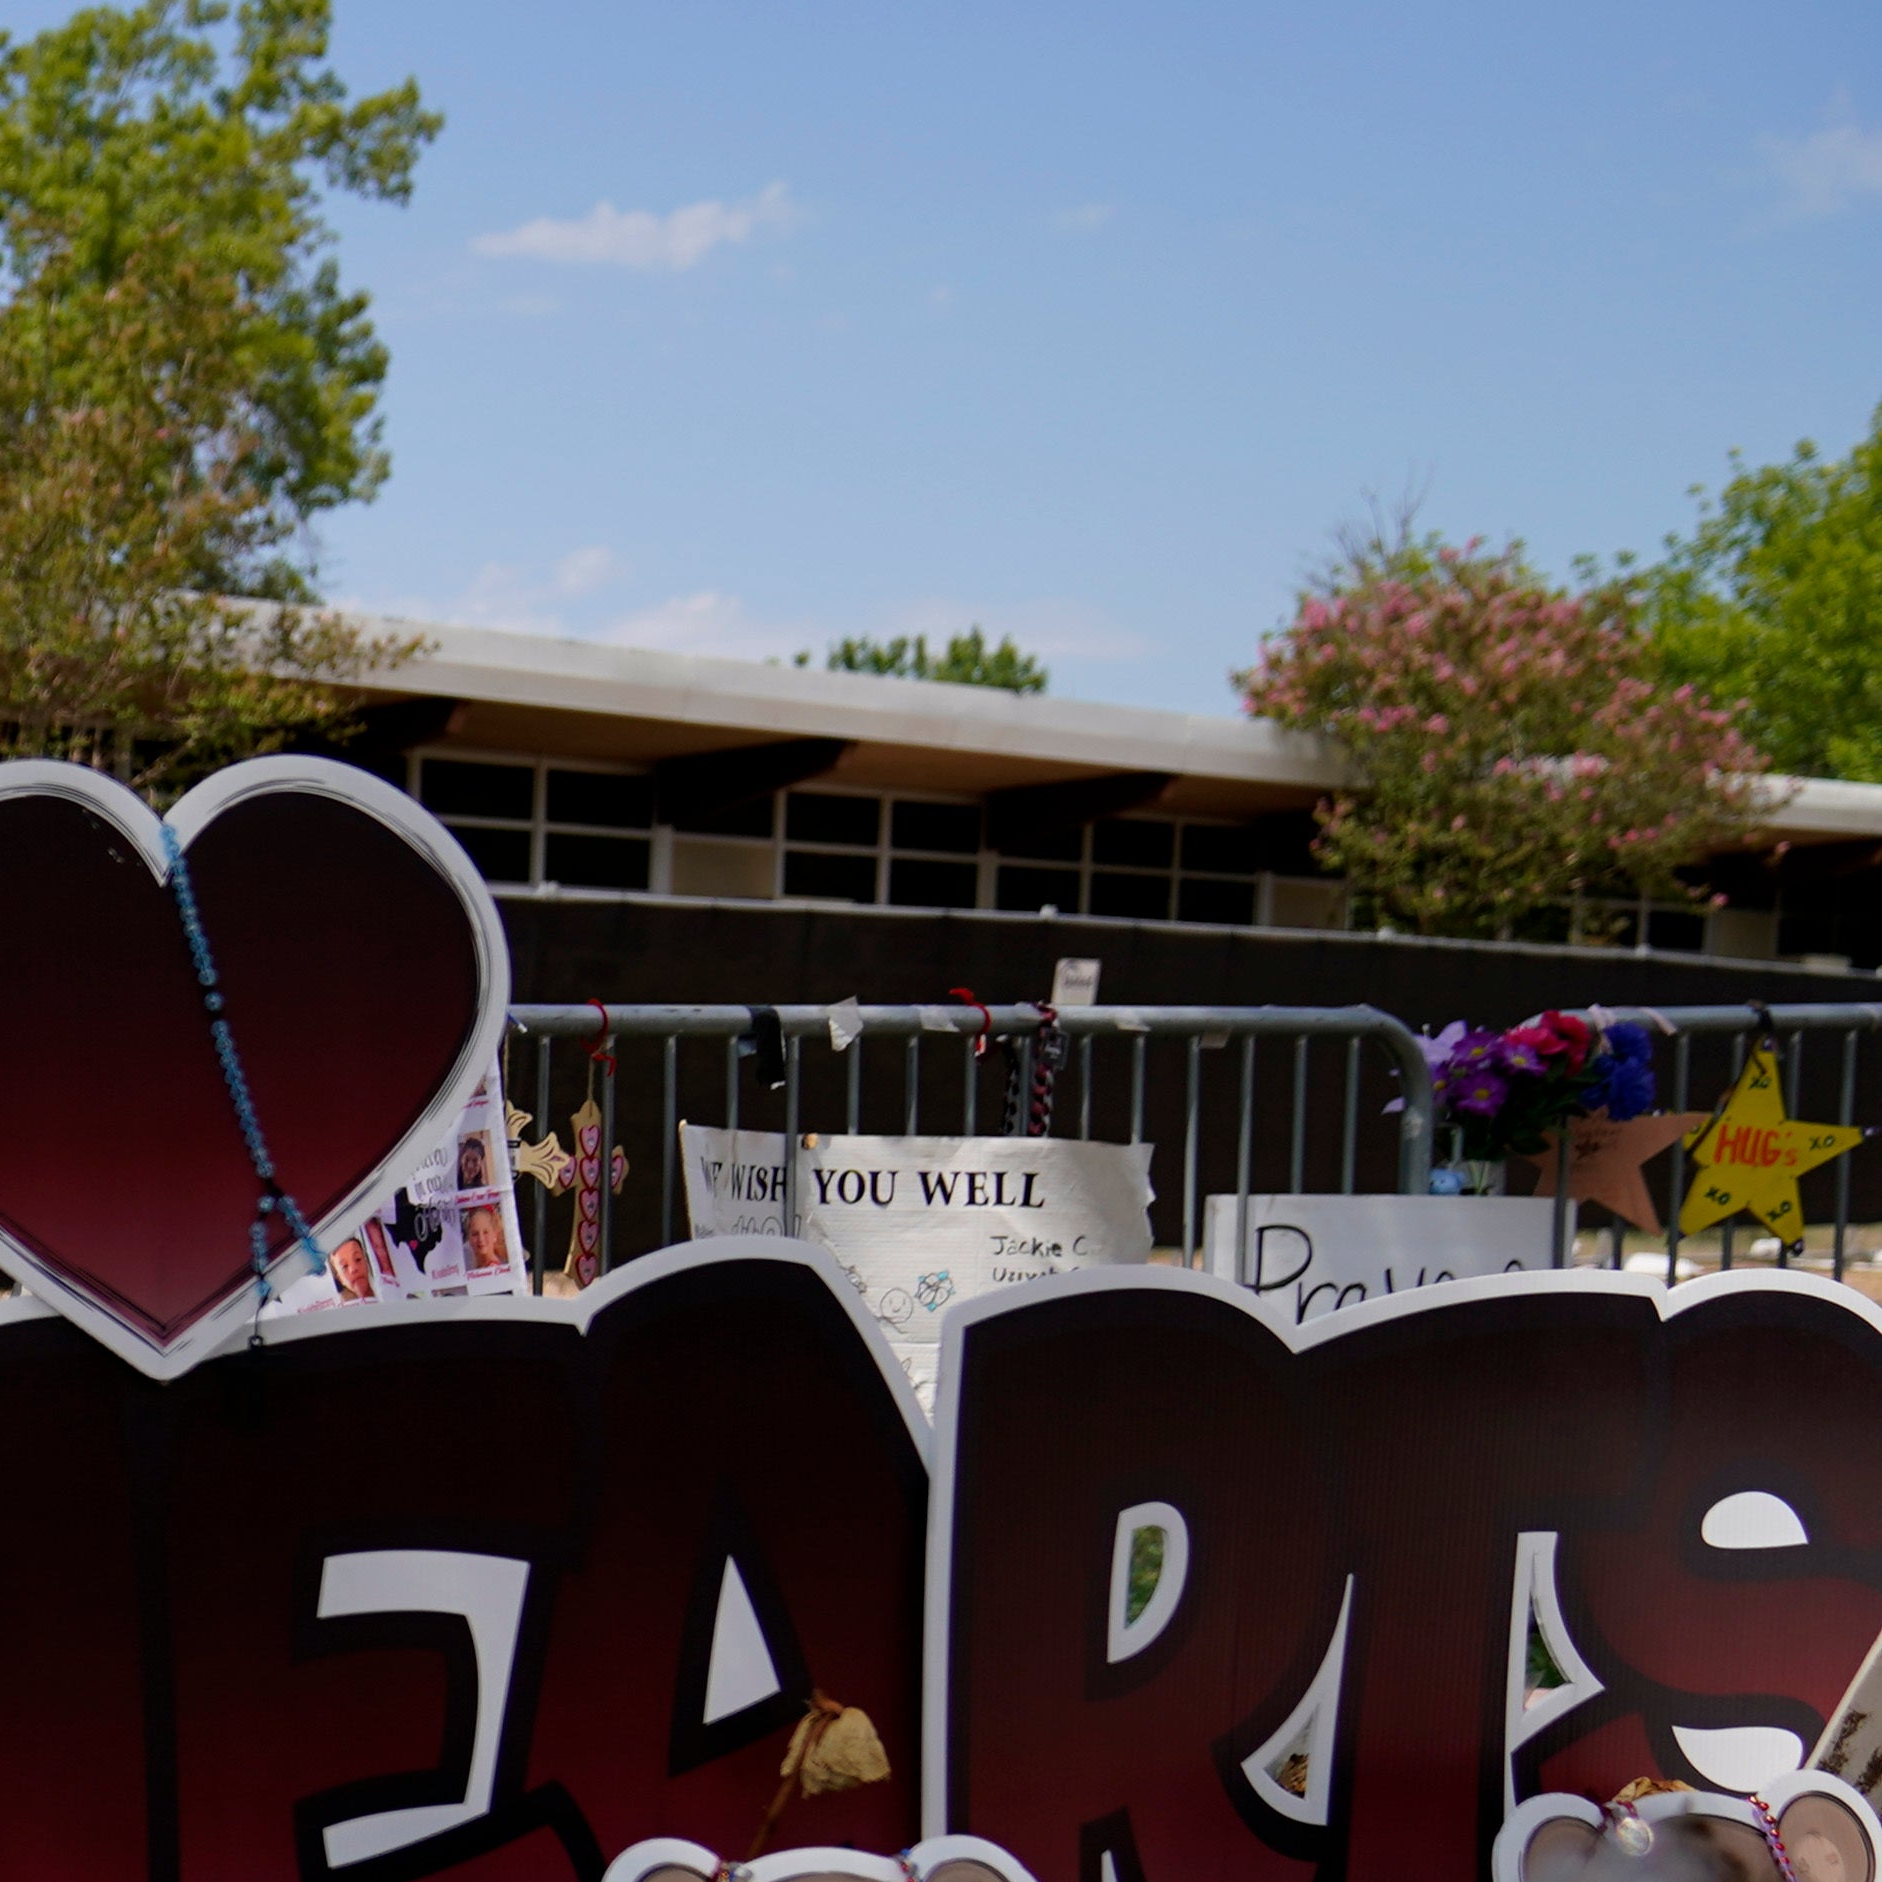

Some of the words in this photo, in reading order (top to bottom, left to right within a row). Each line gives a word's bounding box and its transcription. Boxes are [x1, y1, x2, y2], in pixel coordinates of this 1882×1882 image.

[731, 1164, 787, 1203] WISH
[812, 1167, 900, 1207] YOU
[918, 1171, 1045, 1209] WELL
[989, 1235, 1063, 1257] Jackie
